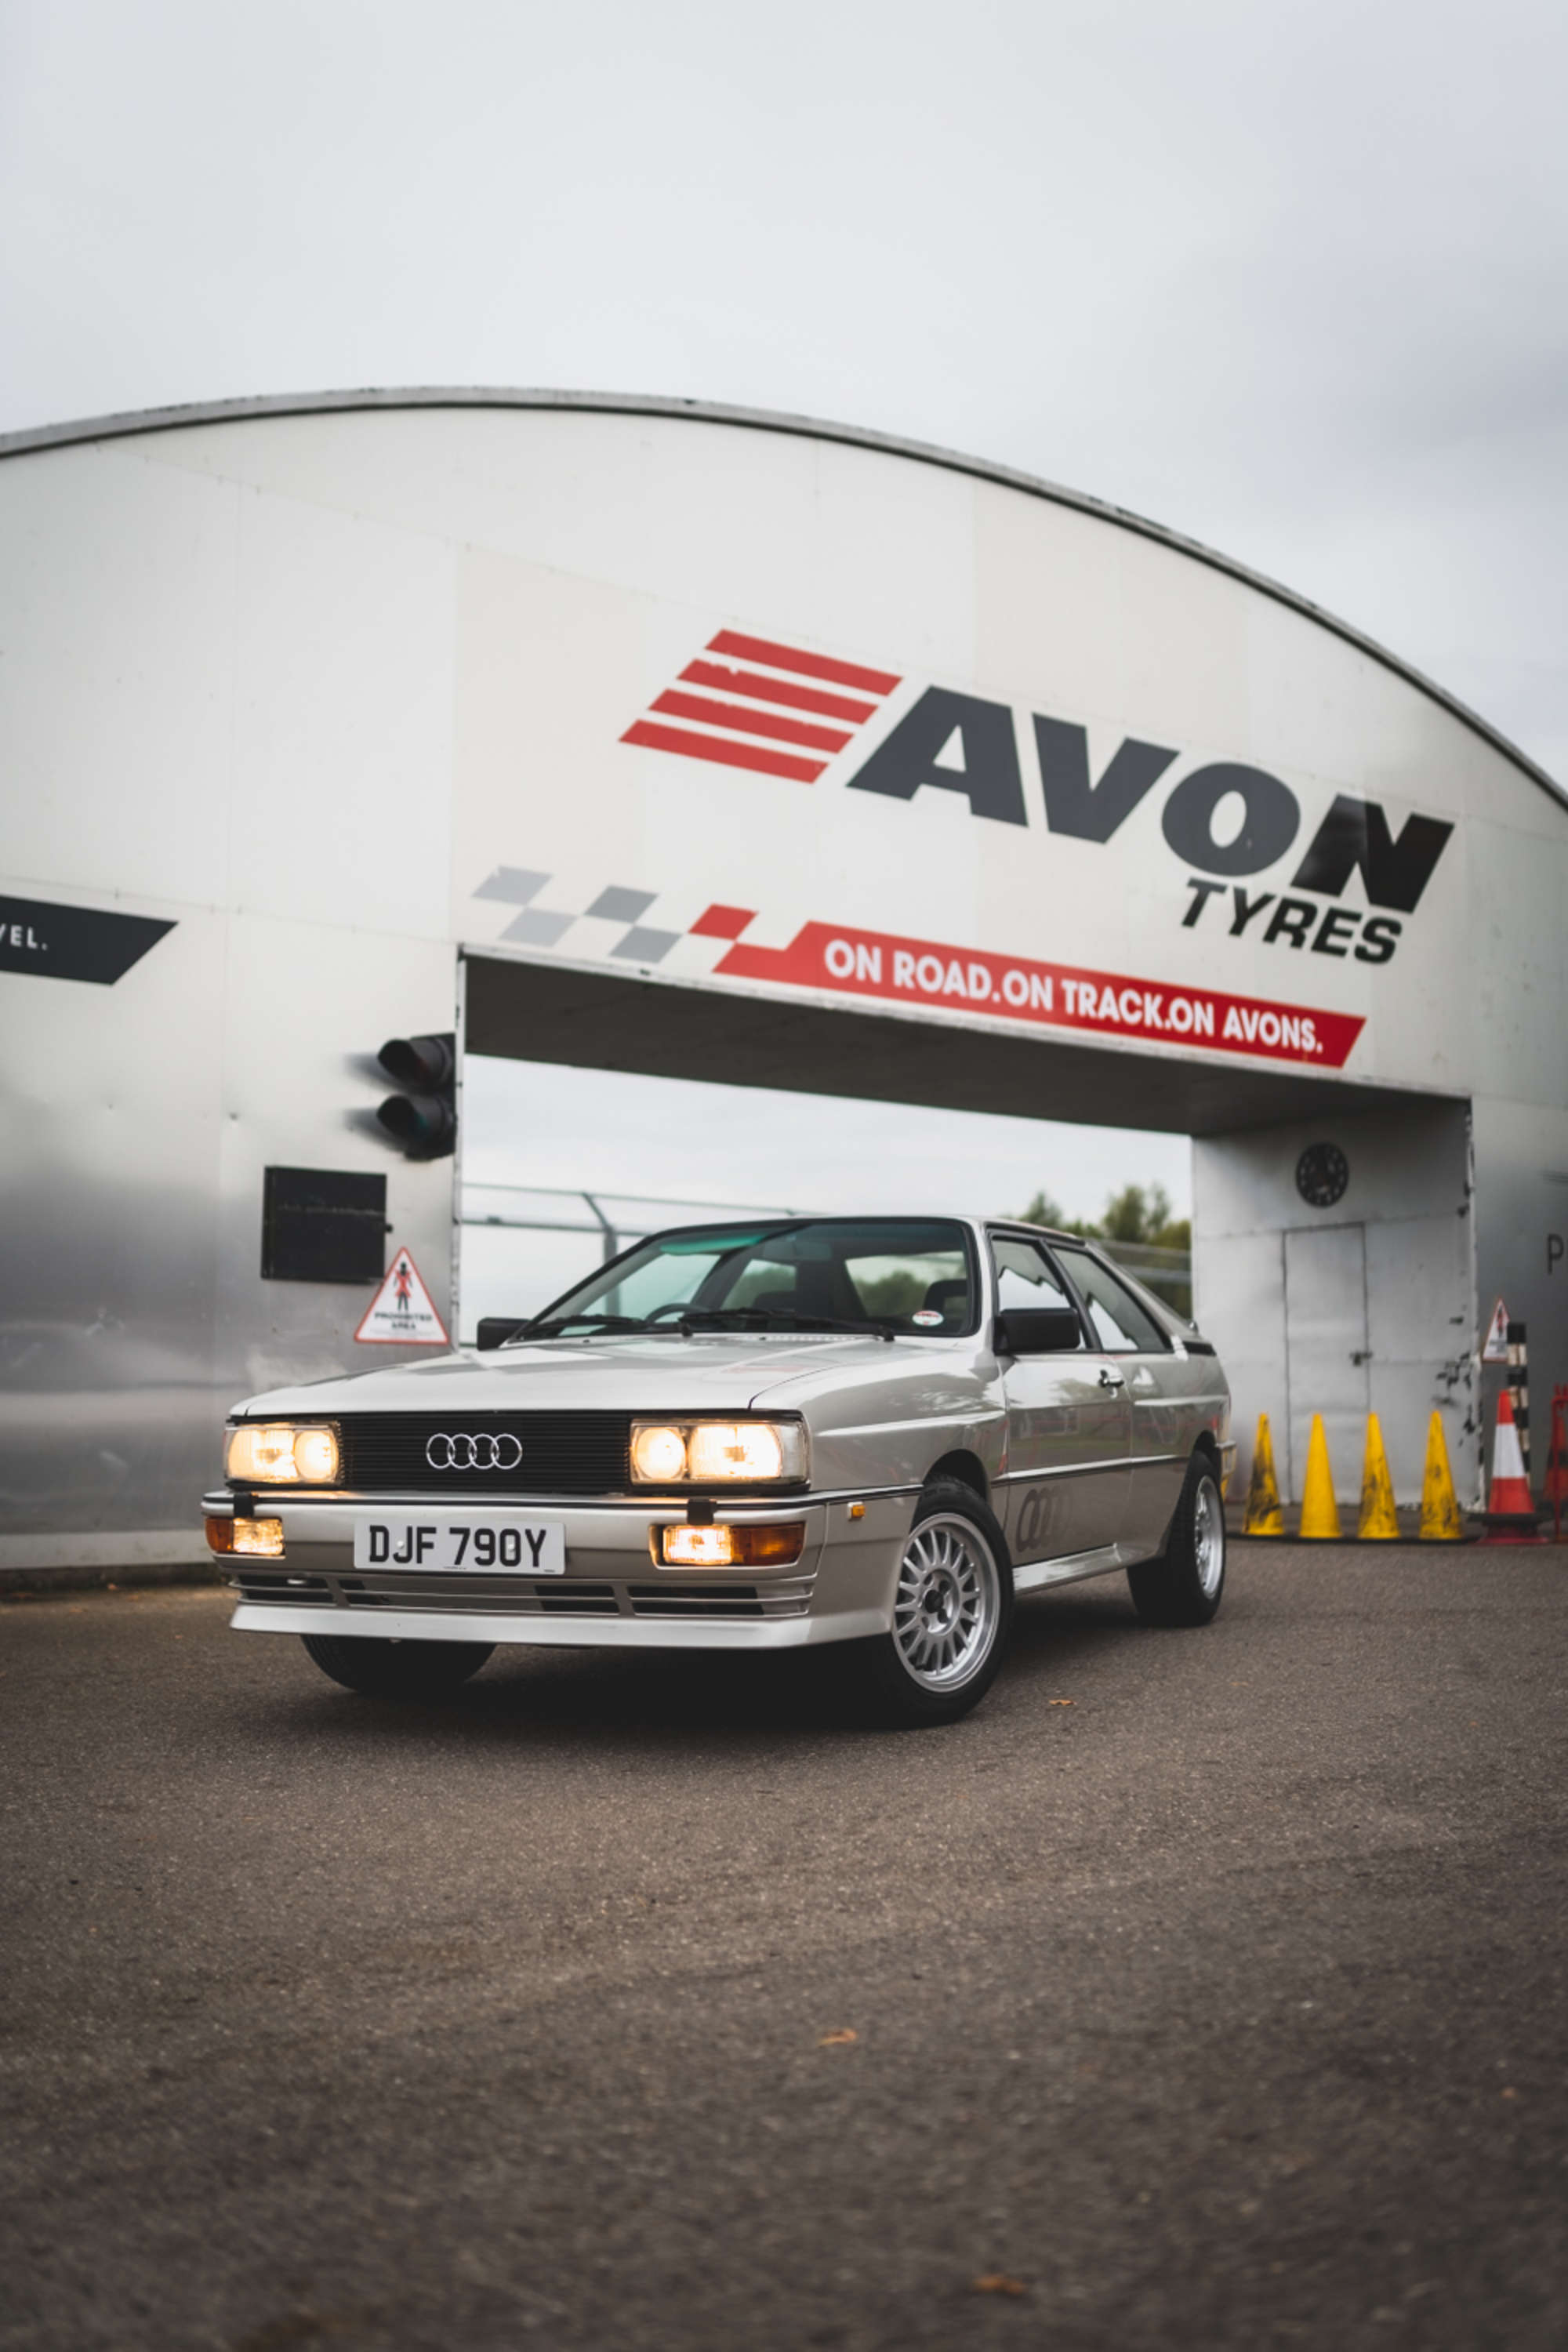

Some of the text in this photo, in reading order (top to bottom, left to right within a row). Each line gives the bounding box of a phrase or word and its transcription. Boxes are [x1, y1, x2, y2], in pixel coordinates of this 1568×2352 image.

[845, 684, 1455, 914] AVON
[1181, 877, 1403, 965] TYRES
[825, 939, 881, 983] ON
[1222, 1005, 1323, 1054] AVONS.
[369, 1525, 546, 1567] DJF 790Y
